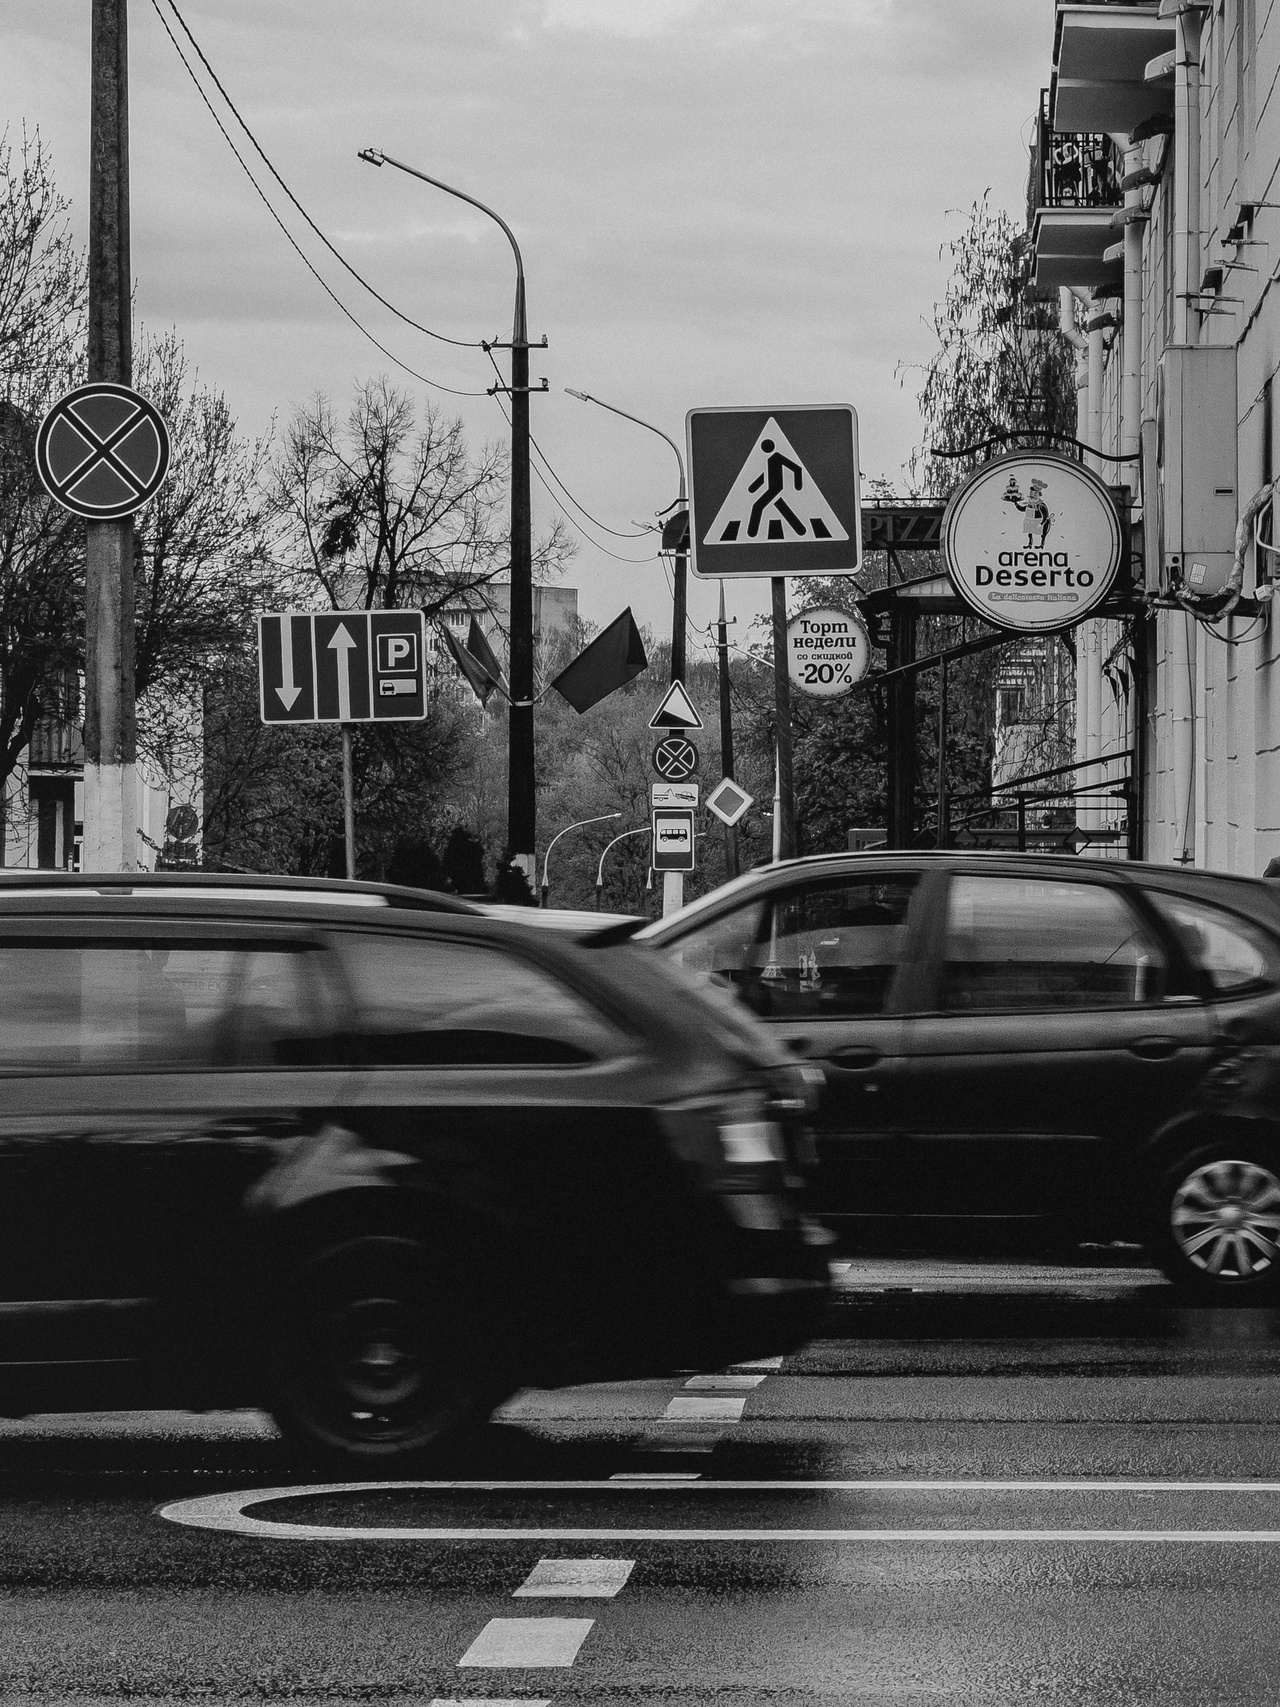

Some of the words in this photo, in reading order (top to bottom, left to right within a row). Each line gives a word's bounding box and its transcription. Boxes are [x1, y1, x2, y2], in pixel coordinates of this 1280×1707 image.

[998, 551, 1068, 567] arena
[975, 565, 1094, 587] Deserto
[793, 636, 857, 650] недели
[811, 651, 853, 661] скидкой
[798, 663, 853, 684] -20%
